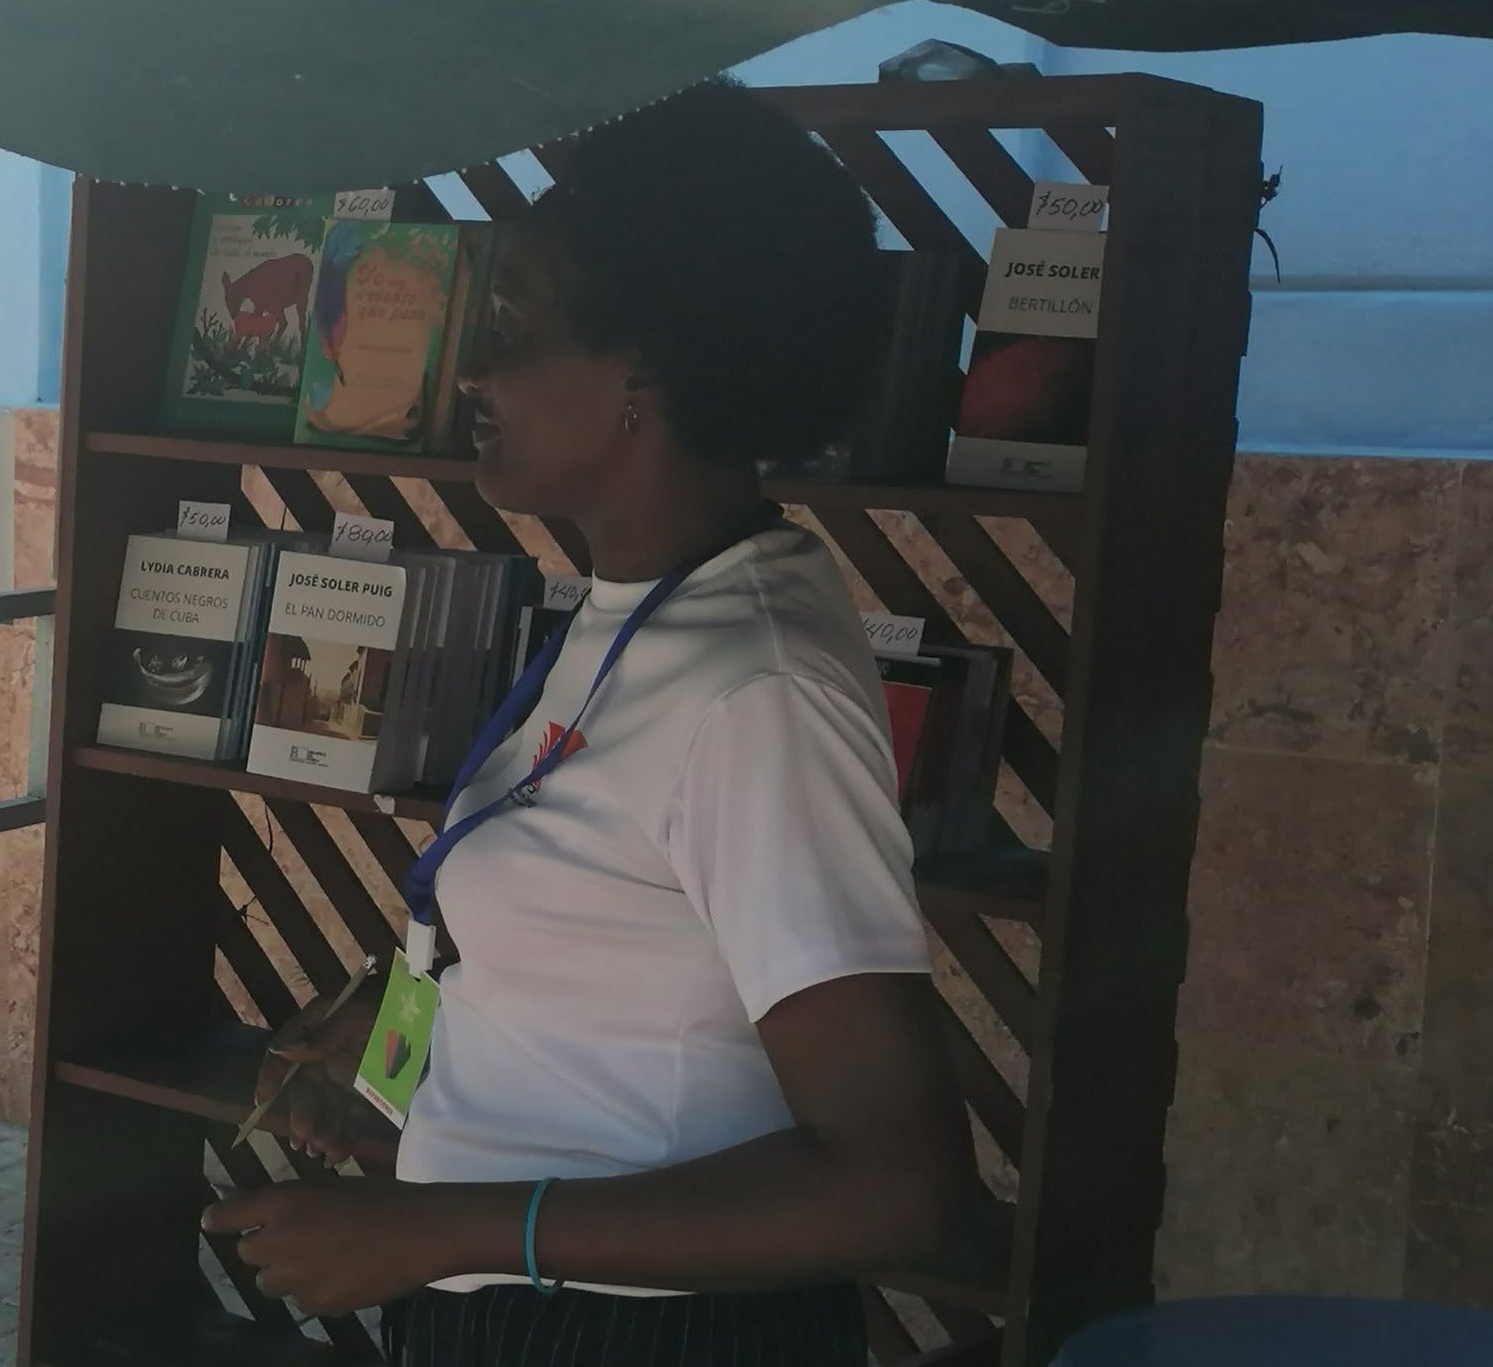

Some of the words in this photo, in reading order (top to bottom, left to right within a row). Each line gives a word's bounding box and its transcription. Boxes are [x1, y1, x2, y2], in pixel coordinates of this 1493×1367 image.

[1036, 190, 1102, 219] $50,00
[1004, 260, 1046, 278] JOSÉ
[1048, 264, 1100, 280] SOLER
[1008, 295, 1093, 314] BERTILLÓN
[179, 506, 227, 527] $50,00
[140, 560, 174, 574] LYDIA
[177, 566, 229, 580] CABRERA
[288, 569, 319, 588] JOSÉ
[320, 576, 359, 593] SOLER
[361, 582, 393, 598] PUIG
[130, 588, 180, 604] CUENTOS
[183, 592, 228, 609] NEGROS
[152, 608, 167, 621] DE
[169, 610, 200, 624] CUBA
[284, 601, 297, 616] EL
[300, 604, 323, 619] PAN
[326, 608, 387, 628] DORMIDO
